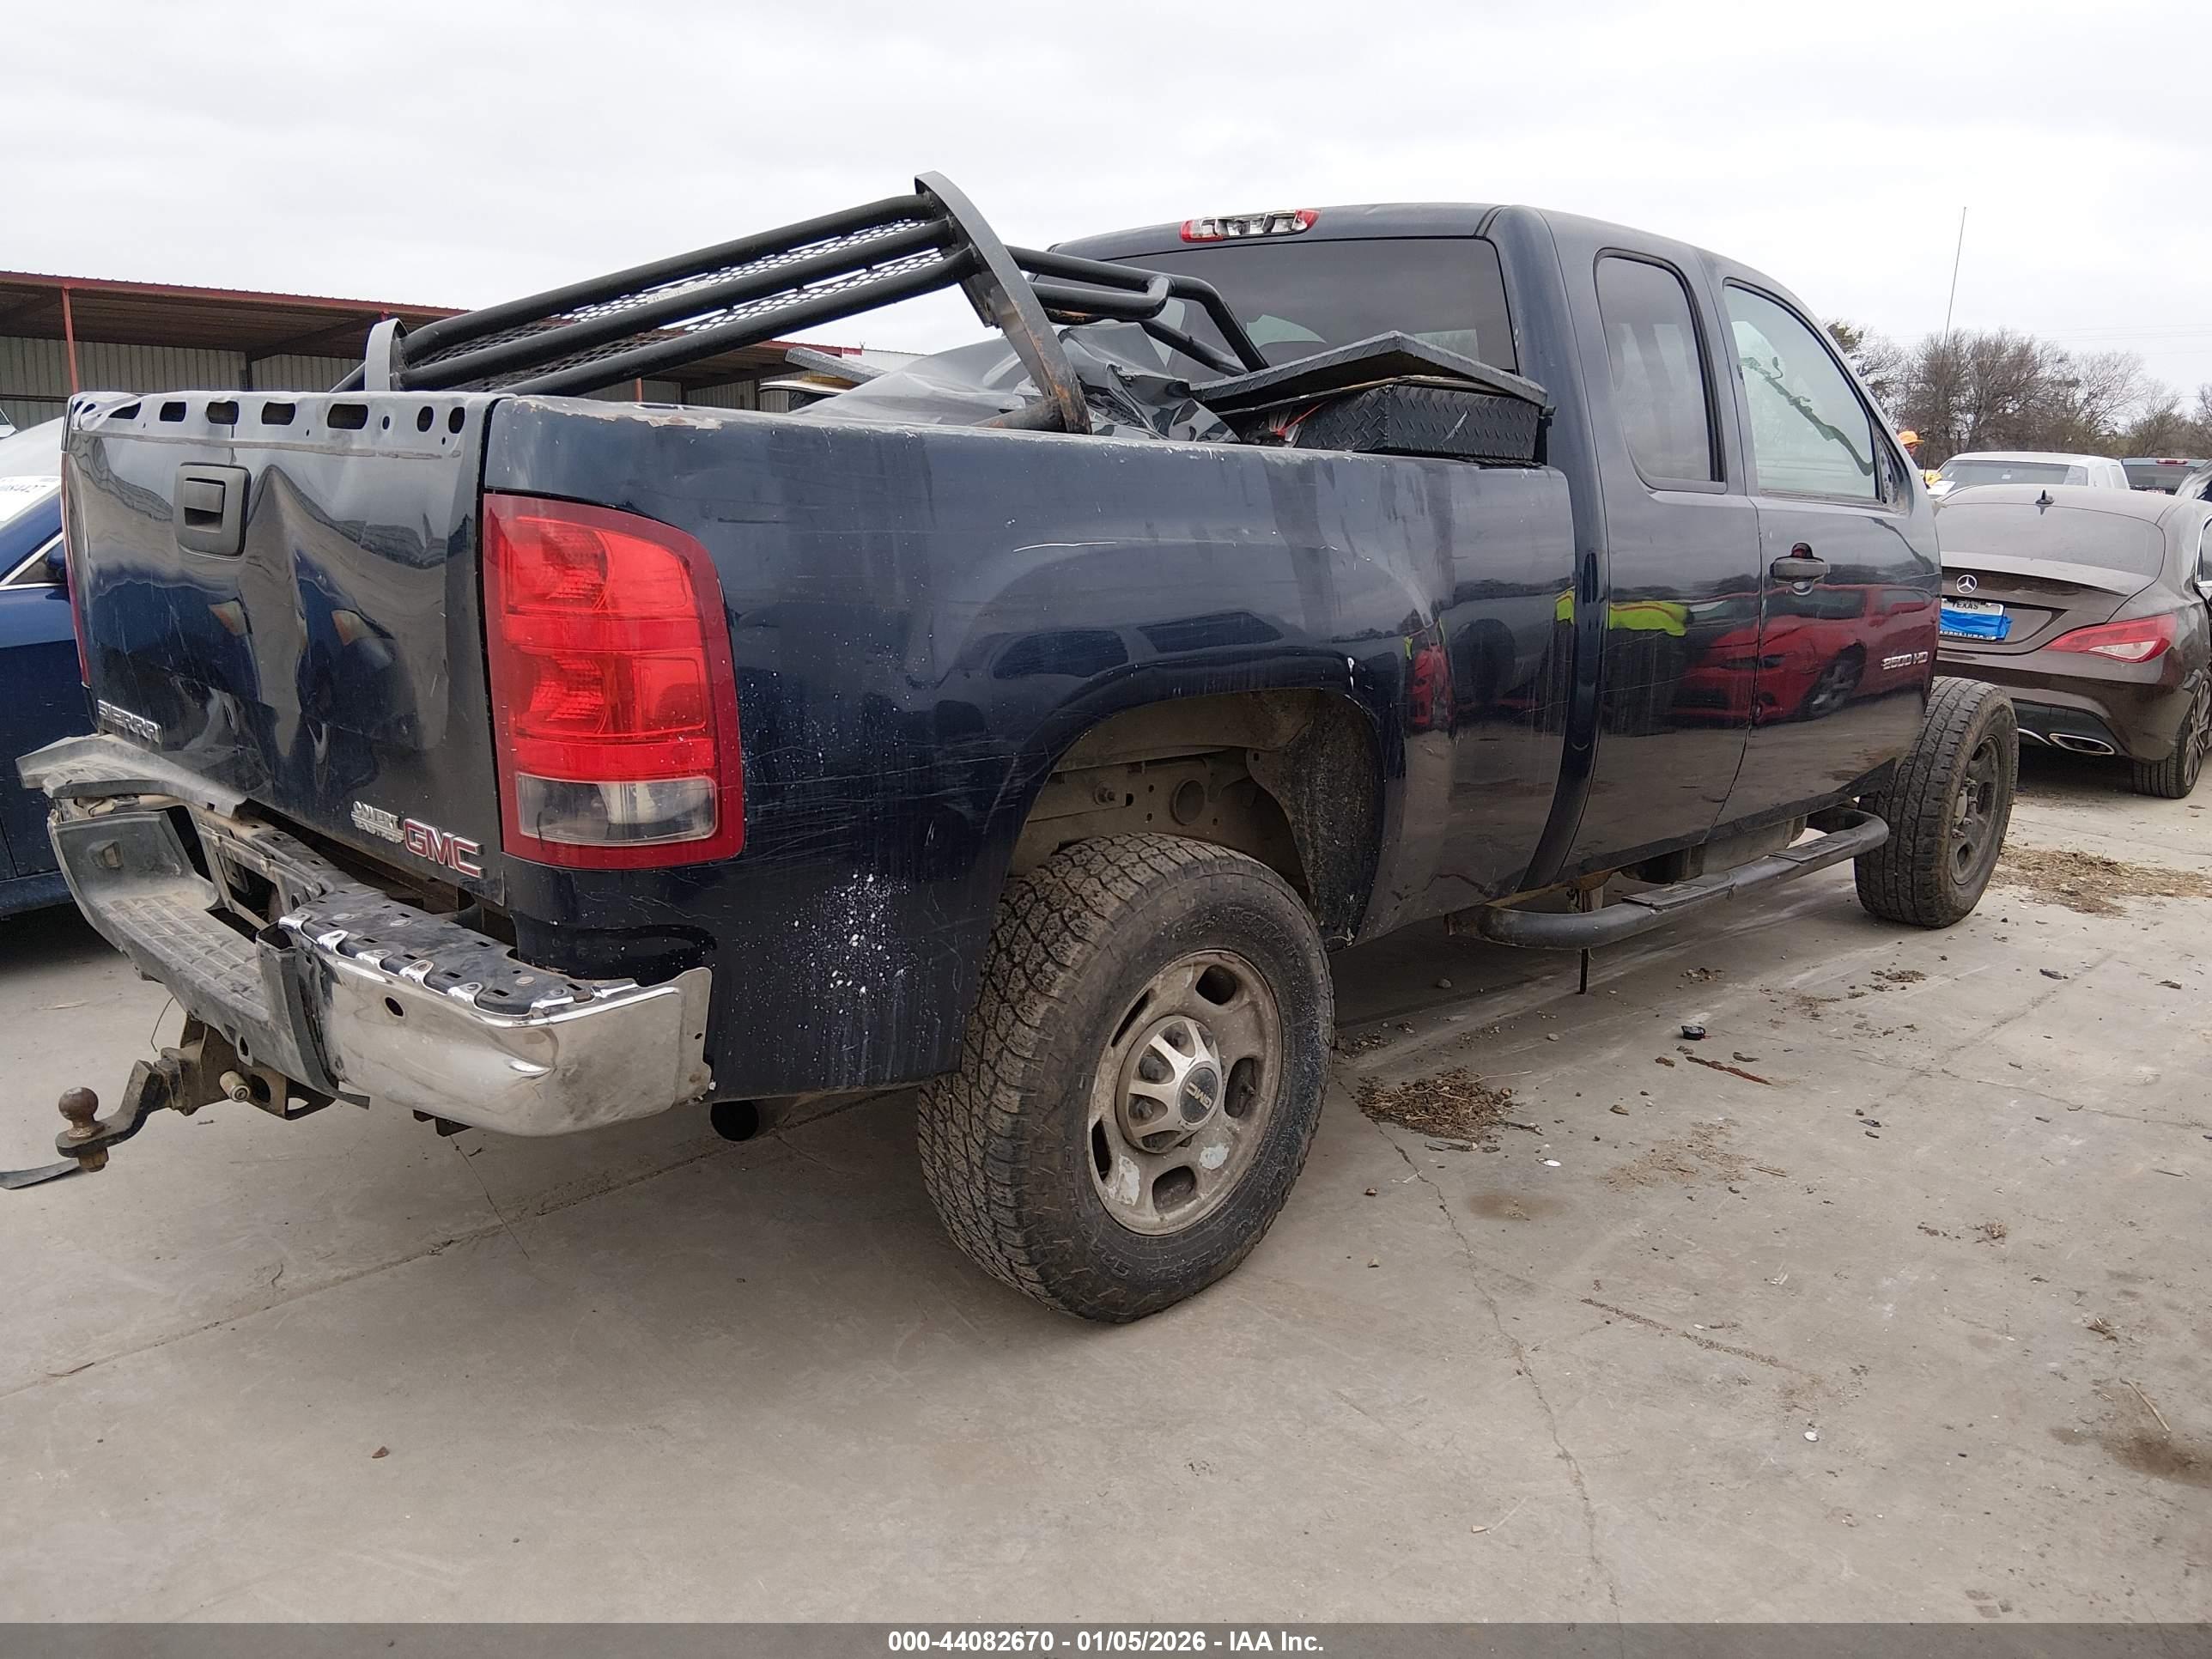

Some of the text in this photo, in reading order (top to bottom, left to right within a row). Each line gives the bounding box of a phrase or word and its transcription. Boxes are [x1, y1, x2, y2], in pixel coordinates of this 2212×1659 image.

[1952, 600, 1979, 611] TEXAS
[1913, 651, 1929, 665] HD
[97, 699, 161, 744] SIERRA
[352, 800, 399, 830] COVERT
[404, 817, 484, 879] GMC
[1186, 1081, 1212, 1109] GMC
